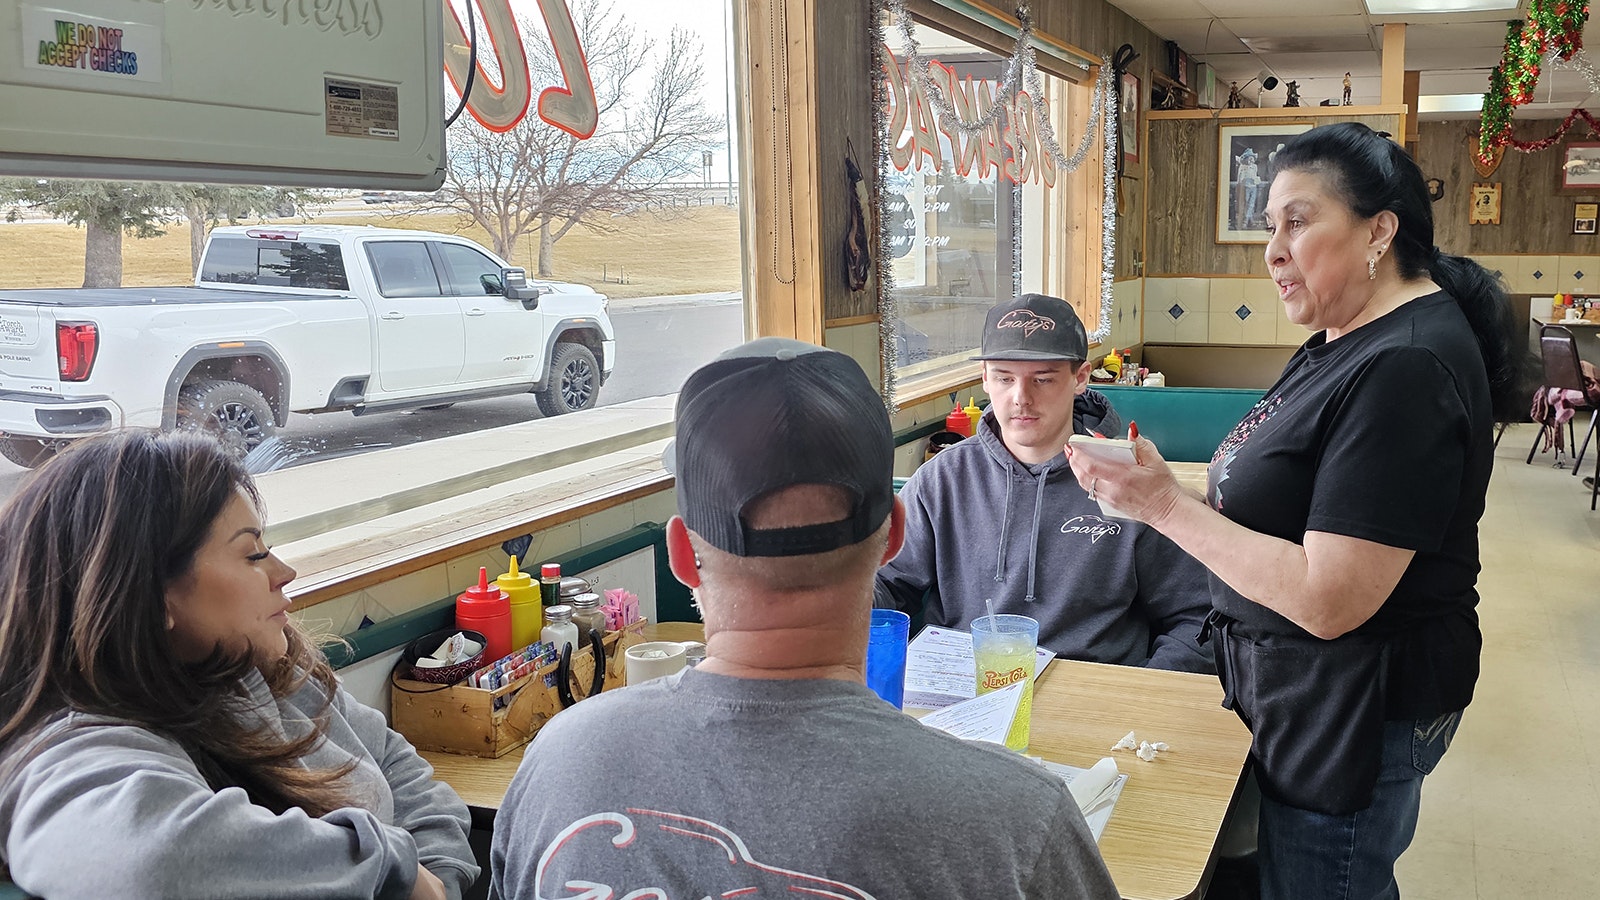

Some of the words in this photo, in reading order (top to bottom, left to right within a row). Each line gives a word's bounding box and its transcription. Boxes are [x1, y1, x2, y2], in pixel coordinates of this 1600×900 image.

[55, 20, 76, 45] WE
[77, 23, 96, 48] DO
[97, 26, 123, 51] NOT
[38, 40, 88, 69] ACCEPT
[89, 47, 138, 75] CHECKS
[924, 184, 945, 196] SAT
